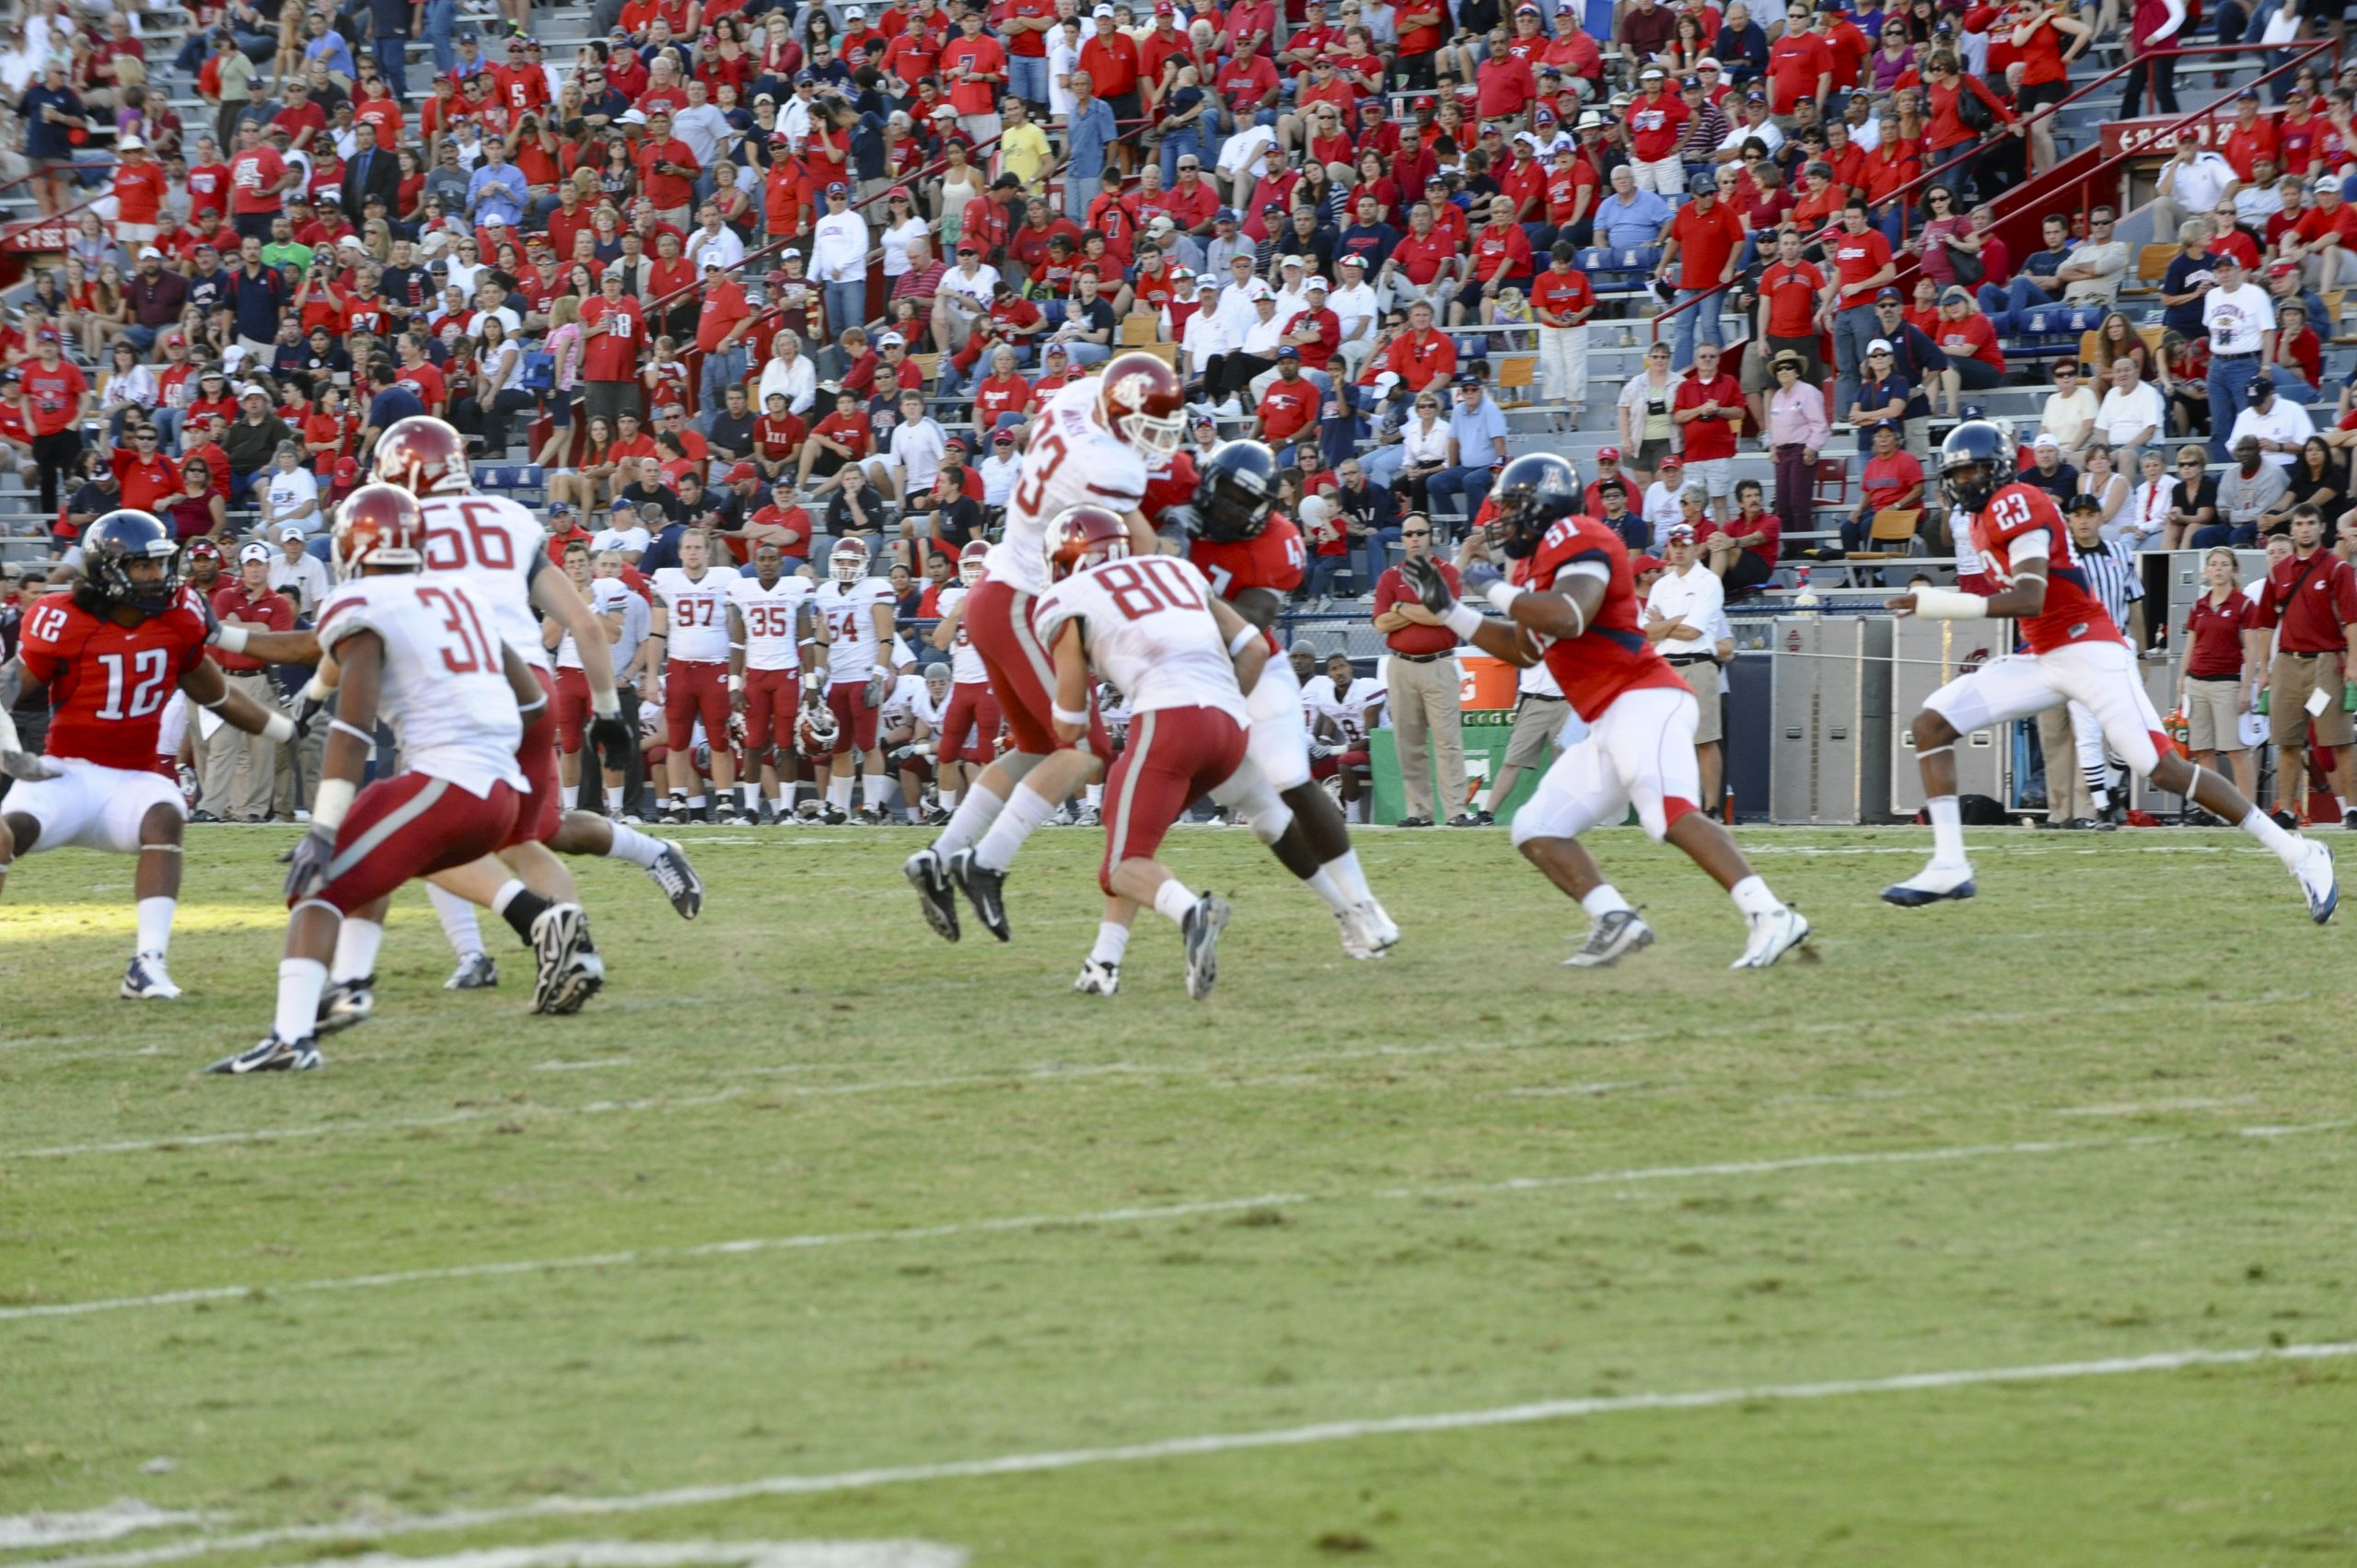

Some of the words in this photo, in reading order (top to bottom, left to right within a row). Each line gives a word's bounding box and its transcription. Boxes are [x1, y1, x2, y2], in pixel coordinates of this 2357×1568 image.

[958, 54, 976, 86] 7
[513, 83, 527, 107] 5
[1104, 211, 1121, 238] 7
[1991, 493, 2032, 531] 23
[378, 527, 412, 550] 31
[422, 503, 515, 571] 56
[1543, 517, 1581, 550] 51
[1094, 560, 1205, 622] 80
[29, 604, 69, 644] 12
[676, 599, 715, 627] 97
[749, 607, 787, 637] 35
[828, 611, 859, 644] 54
[414, 587, 502, 674] 31
[95, 647, 169, 722] 12
[2175, 728, 2189, 743] G
